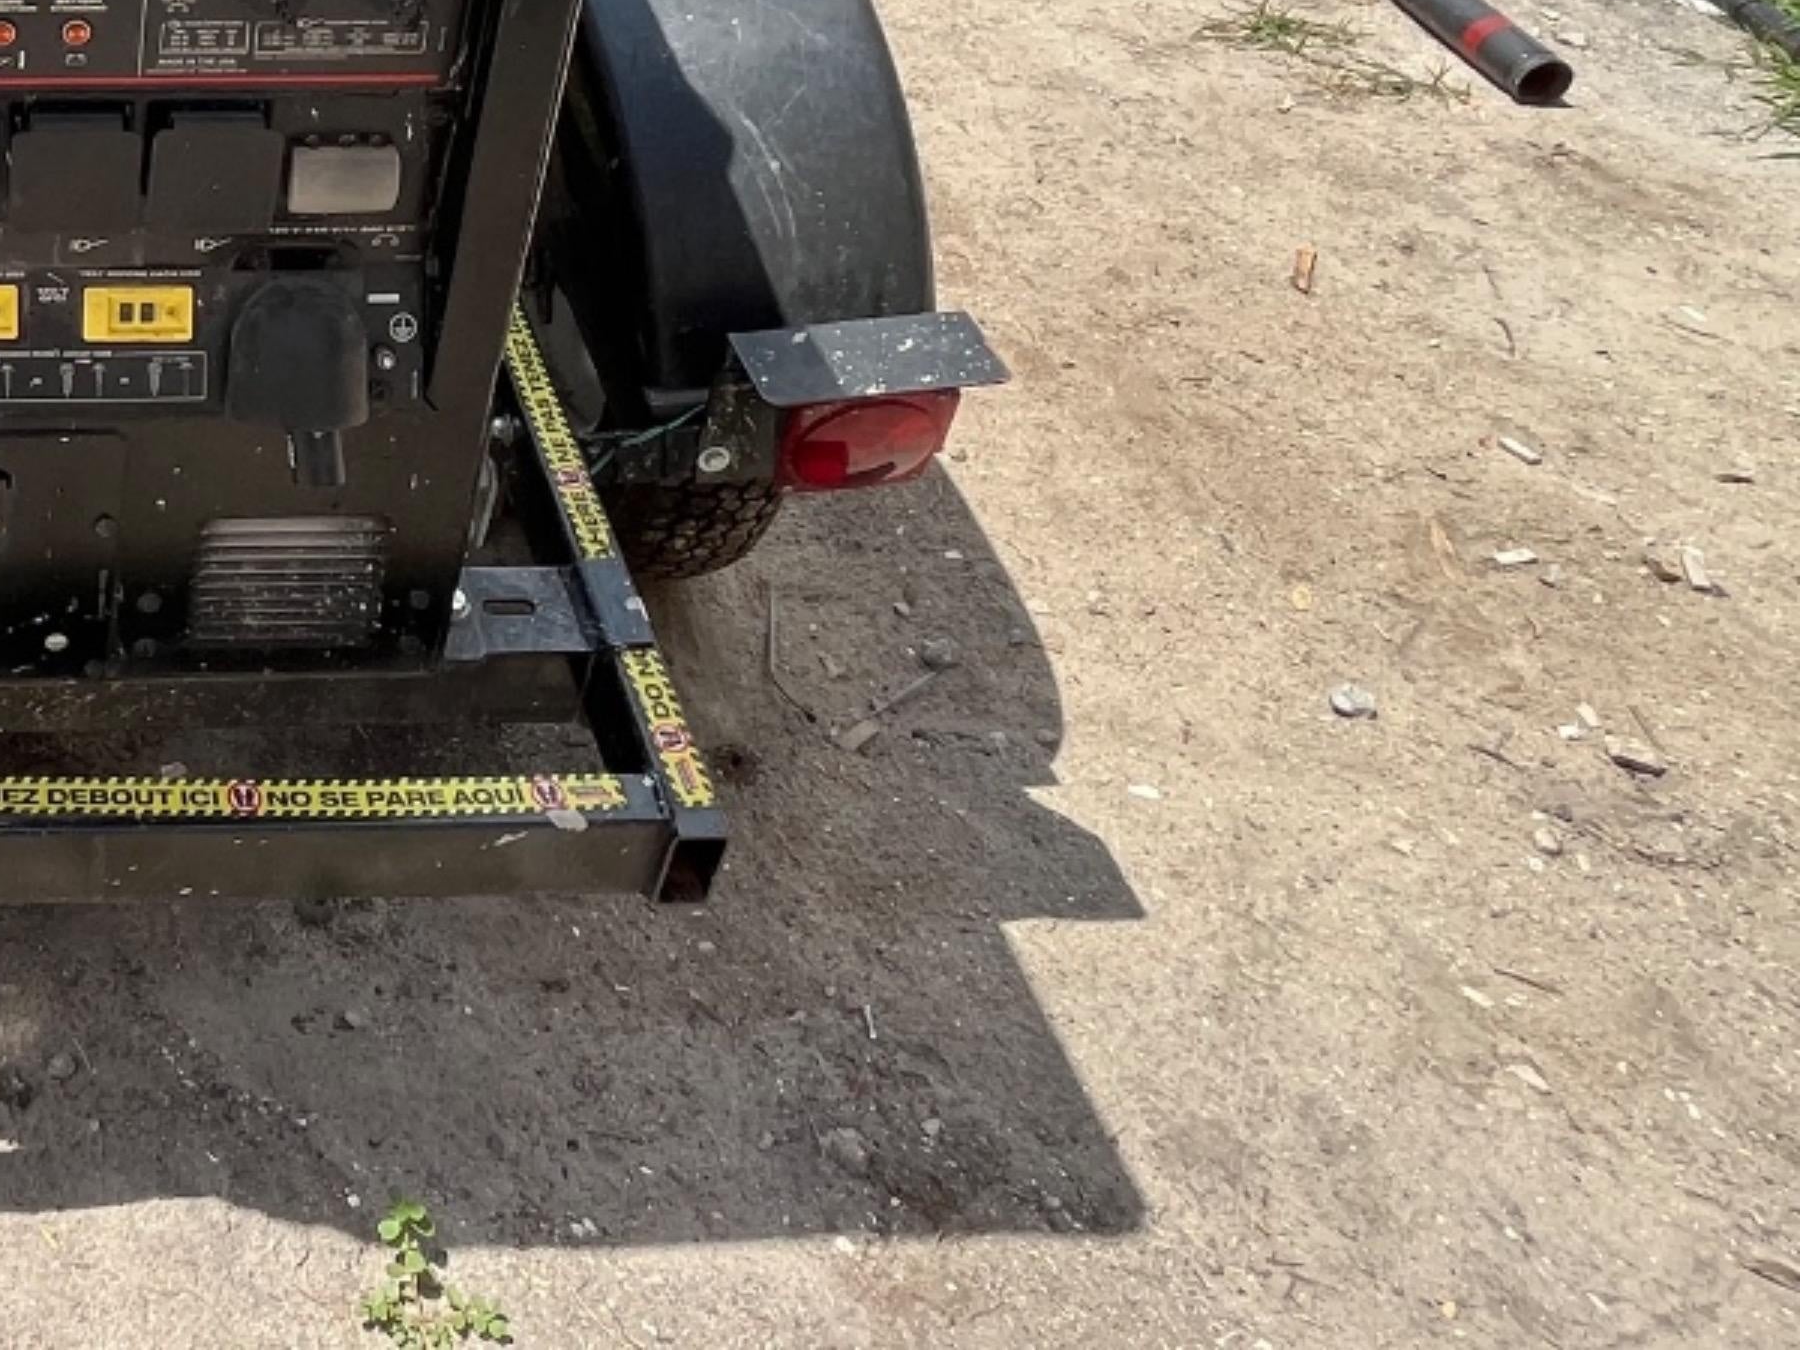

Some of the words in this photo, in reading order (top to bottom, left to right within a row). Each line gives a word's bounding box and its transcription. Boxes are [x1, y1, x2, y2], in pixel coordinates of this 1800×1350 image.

[645, 684, 670, 718] DO
[47, 788, 170, 806] DEBOUT
[179, 788, 220, 806] ICI
[266, 790, 312, 808] NO
[319, 790, 361, 808] SE
[366, 788, 445, 807] PARE
